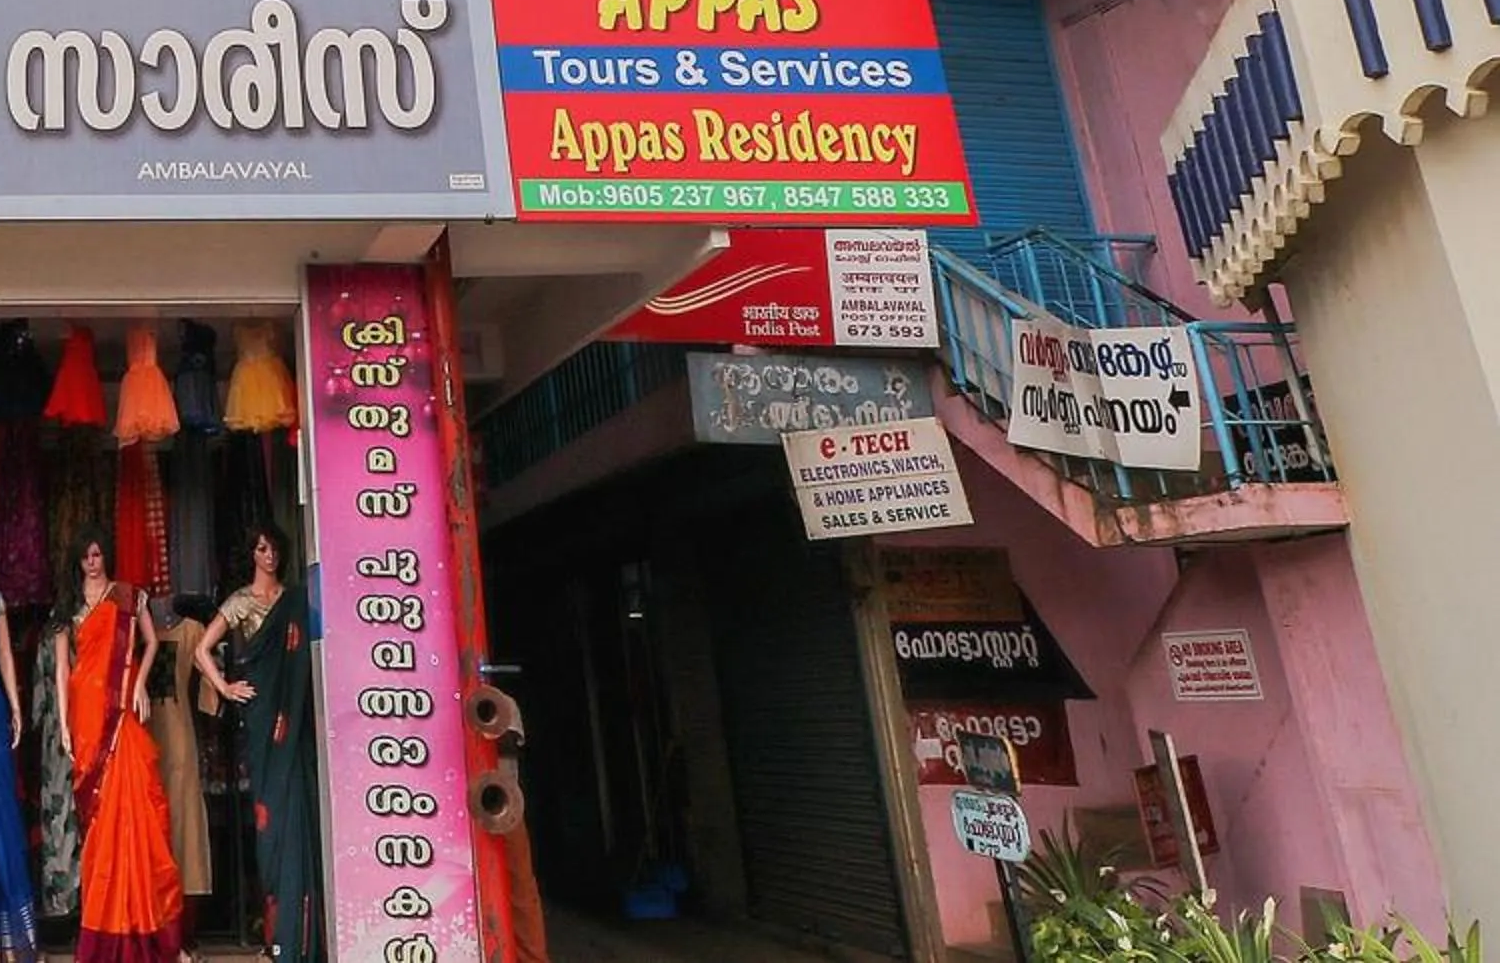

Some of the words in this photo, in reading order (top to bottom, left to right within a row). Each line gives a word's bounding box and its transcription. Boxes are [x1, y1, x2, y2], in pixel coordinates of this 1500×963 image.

[534, 50, 660, 87] Tours
[675, 50, 708, 87] &
[721, 51, 912, 88] Services
[550, 108, 686, 174] Appas
[692, 109, 918, 176] Residency
[138, 161, 312, 182] AMBALAVAYAL
[539, 185, 662, 207] Mob:9605
[673, 185, 712, 207] 237
[784, 186, 842, 208] 8547
[852, 187, 895, 208] 588
[905, 187, 950, 208] 333
[742, 302, 789, 320] भारतीय
[841, 300, 926, 312] AMBALAVAYAL
[745, 320, 785, 335] India
[790, 321, 820, 336] Post
[841, 313, 875, 322] POST
[880, 313, 926, 322] OFFICE
[847, 325, 882, 337] 673
[889, 325, 925, 338] 593
[813, 492, 824, 506] &
[826, 489, 864, 505] HOME
[869, 480, 950, 501] APPLIANCES
[822, 513, 868, 530] SALES
[872, 510, 883, 524] &
[887, 504, 951, 523] SERVICE
